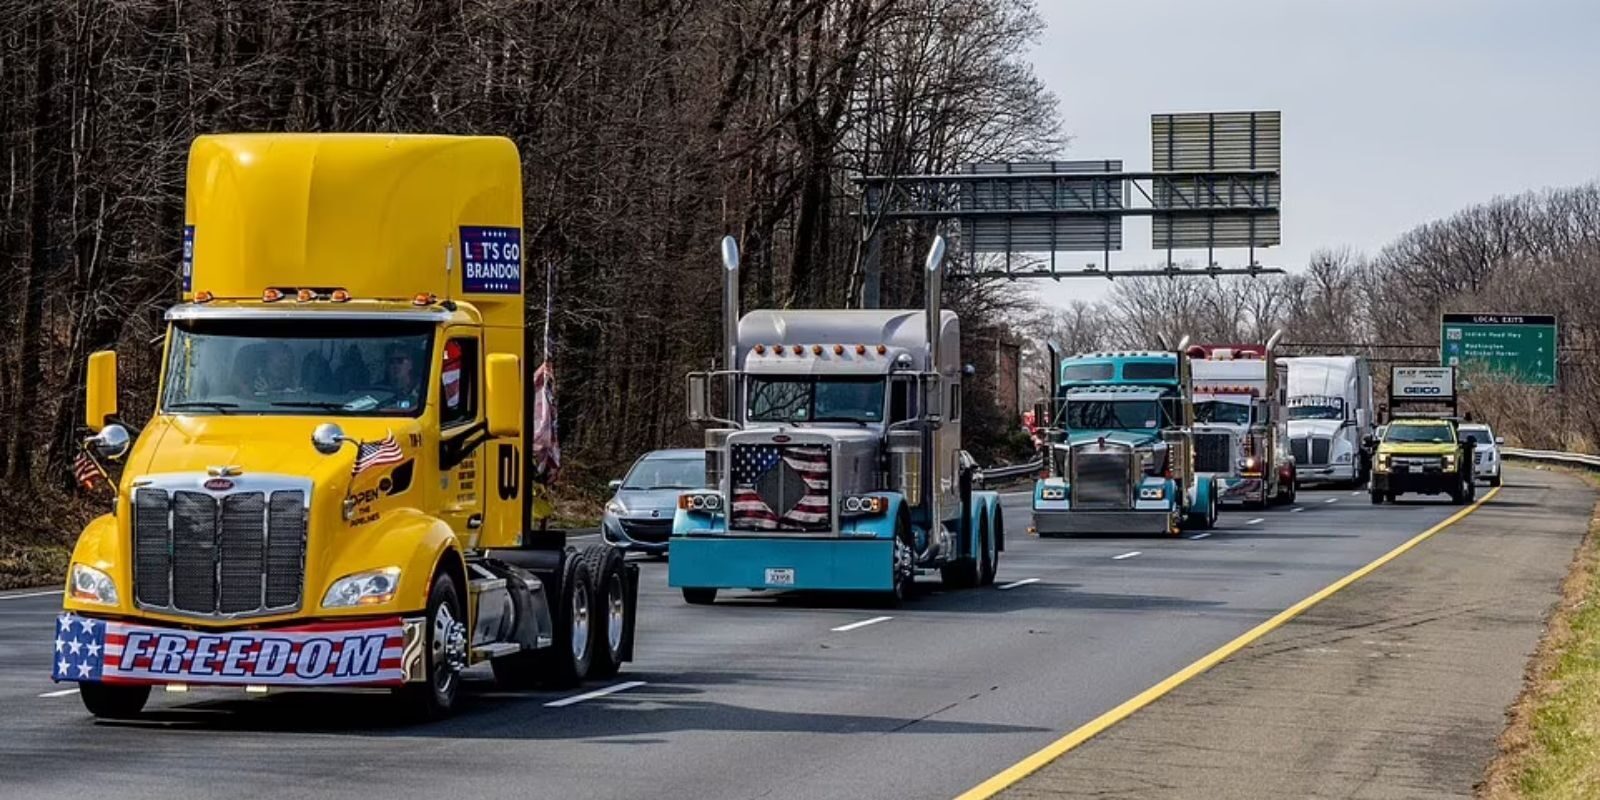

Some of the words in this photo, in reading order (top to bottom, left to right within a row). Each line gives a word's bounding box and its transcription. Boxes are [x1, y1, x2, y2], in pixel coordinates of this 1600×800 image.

[503, 242, 520, 261] GO
[466, 261, 520, 279] BRANDON
[1403, 386, 1441, 395] GEICO
[117, 631, 390, 678] FREEDOM
